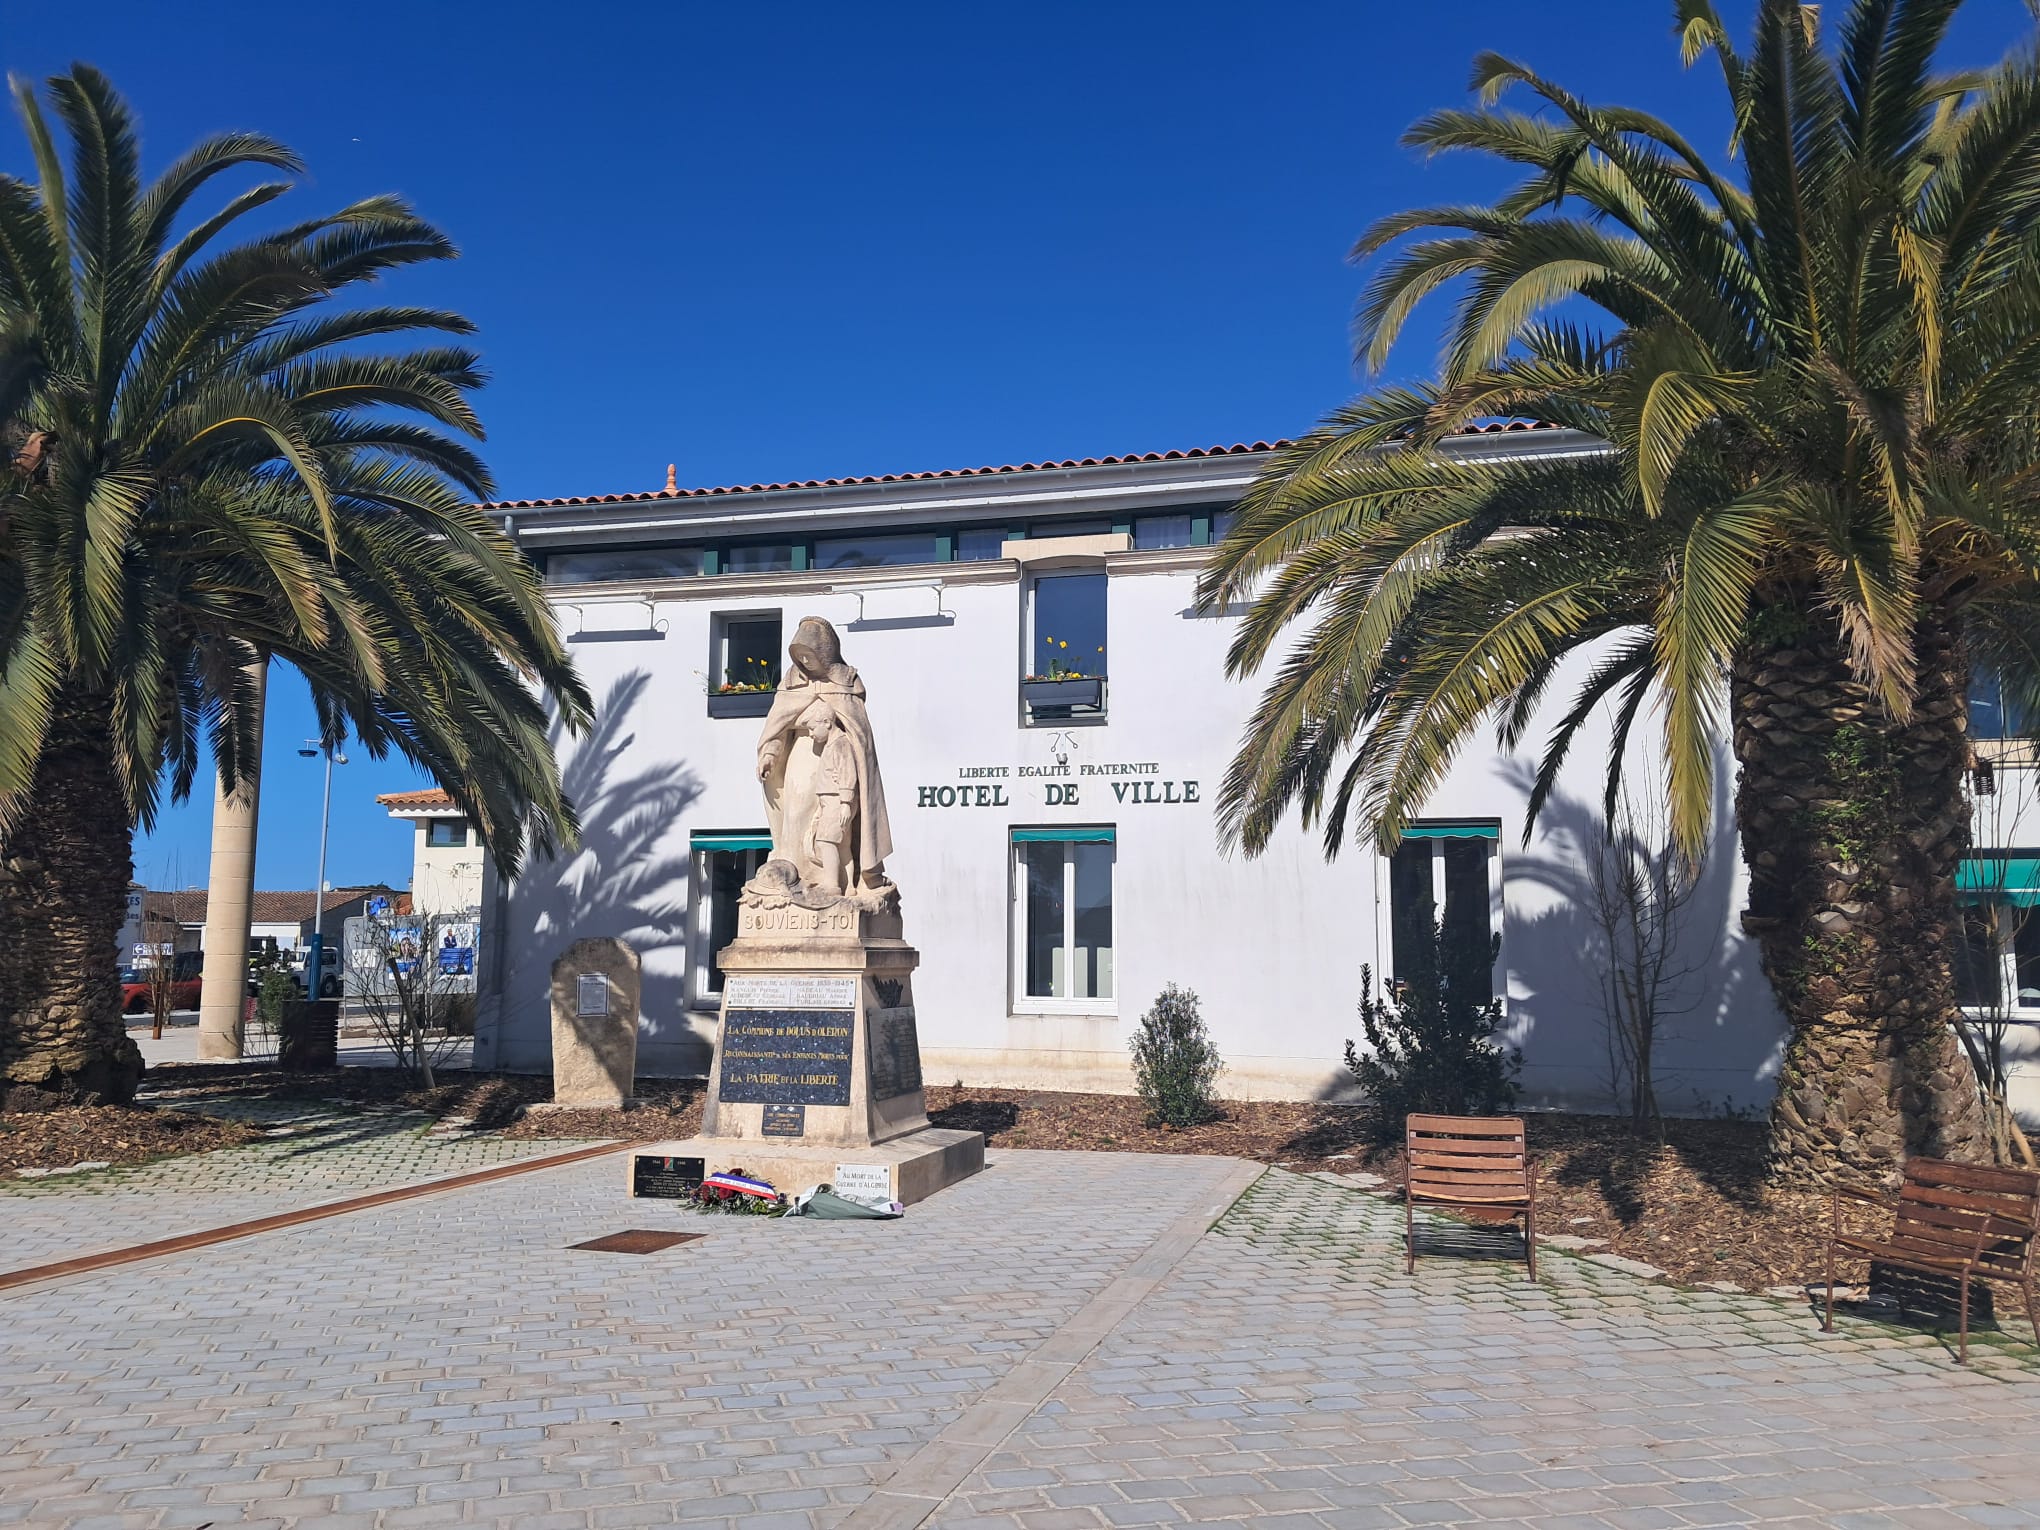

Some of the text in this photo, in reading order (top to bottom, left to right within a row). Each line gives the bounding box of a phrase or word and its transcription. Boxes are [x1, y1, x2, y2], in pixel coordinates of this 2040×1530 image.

[959, 763, 1159, 778] LIBERTE EGALITE FRATERNITE
[917, 780, 1200, 808] HOTEL DE VILLE
[727, 1025, 740, 1035] LA
[742, 1025, 774, 1036] COMMUNE
[786, 1026, 810, 1037] DOLUS
[730, 1073, 742, 1083] LA
[746, 1073, 779, 1084] PATRIE
[781, 1076, 789, 1084] ET
[801, 1074, 839, 1086] LIBERTE
